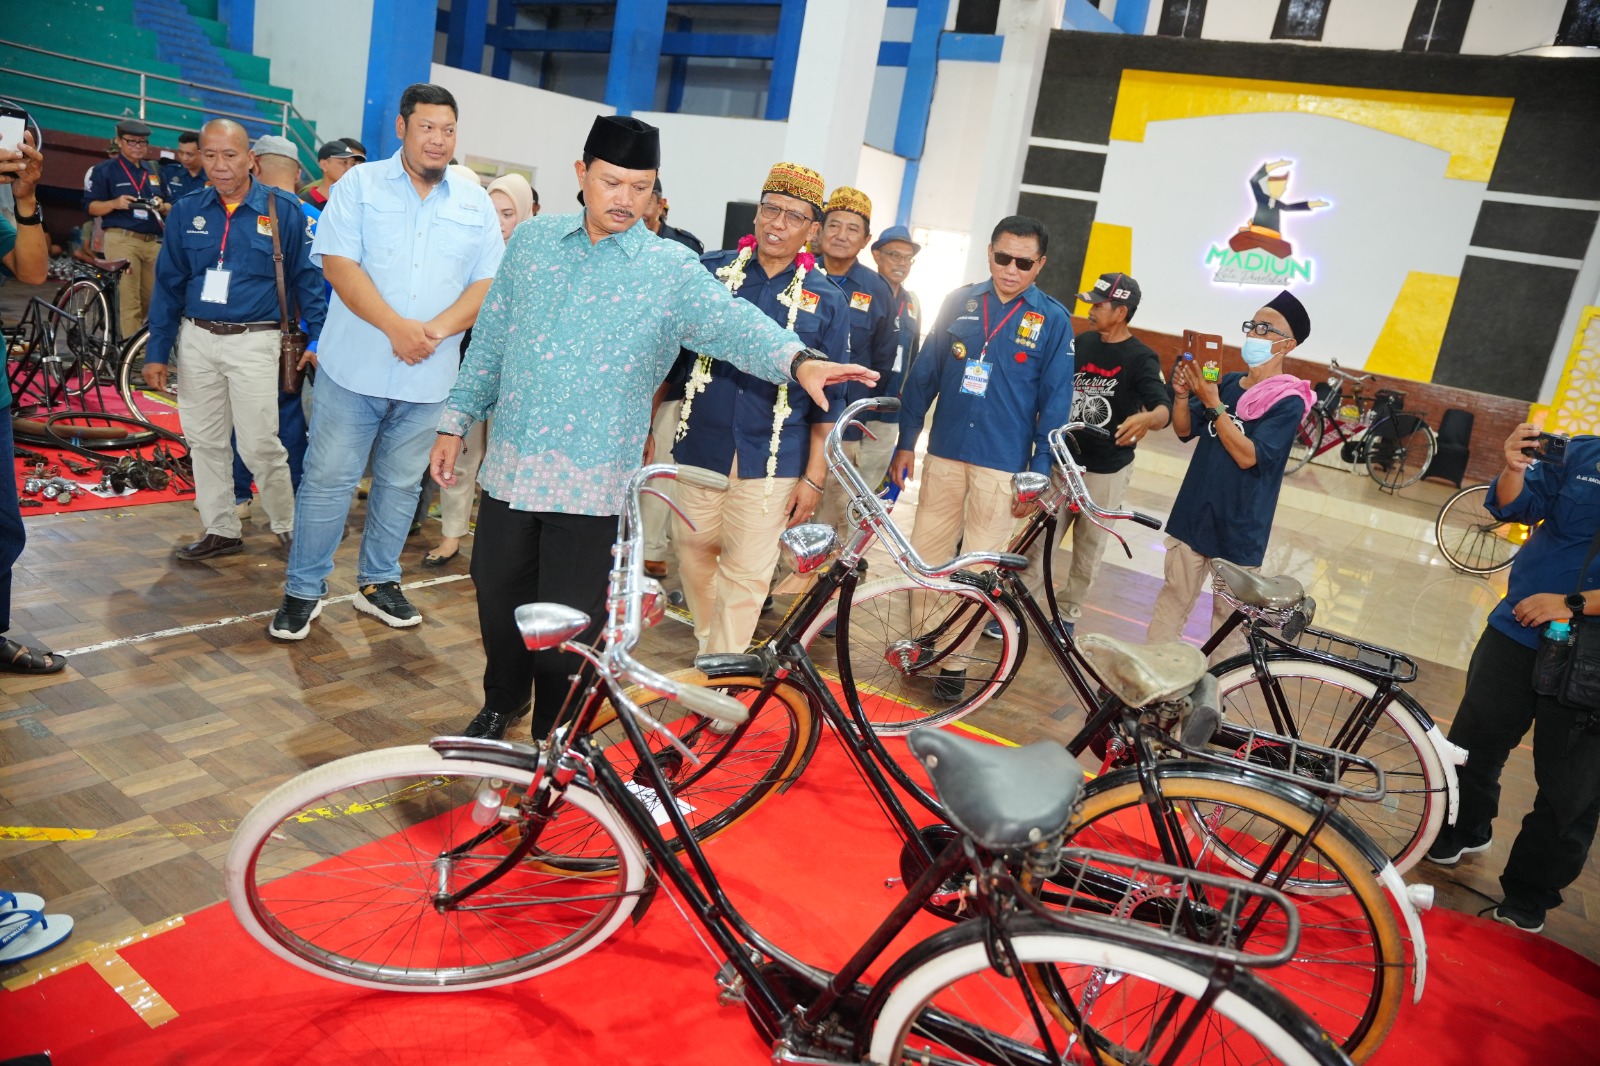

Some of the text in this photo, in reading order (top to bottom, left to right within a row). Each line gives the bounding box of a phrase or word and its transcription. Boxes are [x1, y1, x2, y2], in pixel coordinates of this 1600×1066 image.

[1205, 246, 1311, 282] MADIUN
[1113, 288, 1131, 299] 93
[1073, 372, 1119, 394] Touring
